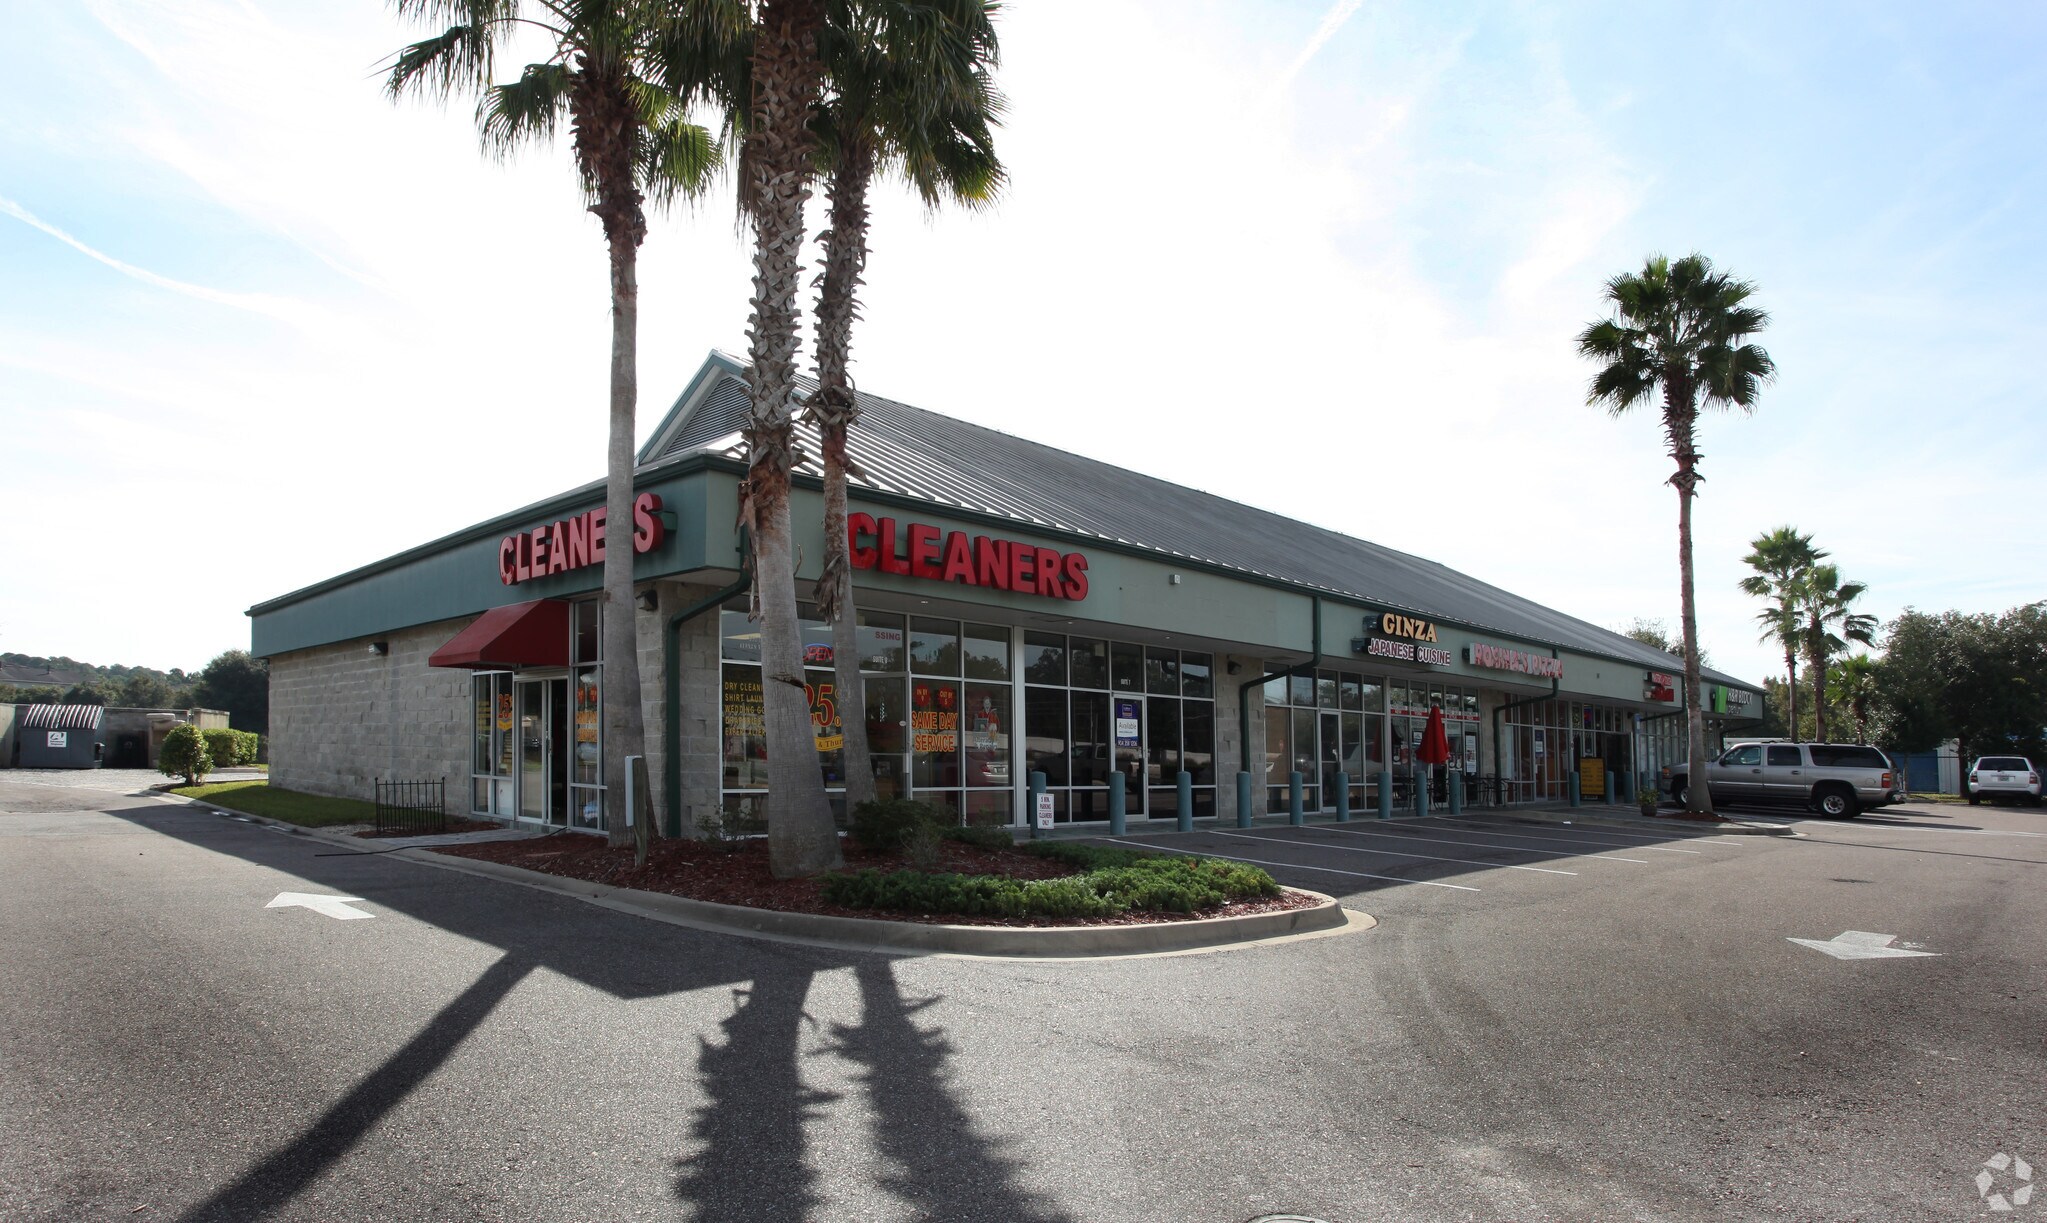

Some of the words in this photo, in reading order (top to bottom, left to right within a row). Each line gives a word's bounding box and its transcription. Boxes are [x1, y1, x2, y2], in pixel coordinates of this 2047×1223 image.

[499, 492, 663, 586] CLEANES
[847, 512, 1088, 601] CLEANERS
[1382, 612, 1438, 643] GINZA
[1368, 638, 1414, 661] JAPANESE
[1416, 646, 1450, 666] CUISINE
[724, 681, 738, 690] DRY
[725, 693, 744, 702] SHIRT
[725, 704, 755, 713] WEDDING
[911, 710, 938, 730] SAME
[939, 711, 958, 730] DAY
[915, 733, 955, 752] SERVICE
